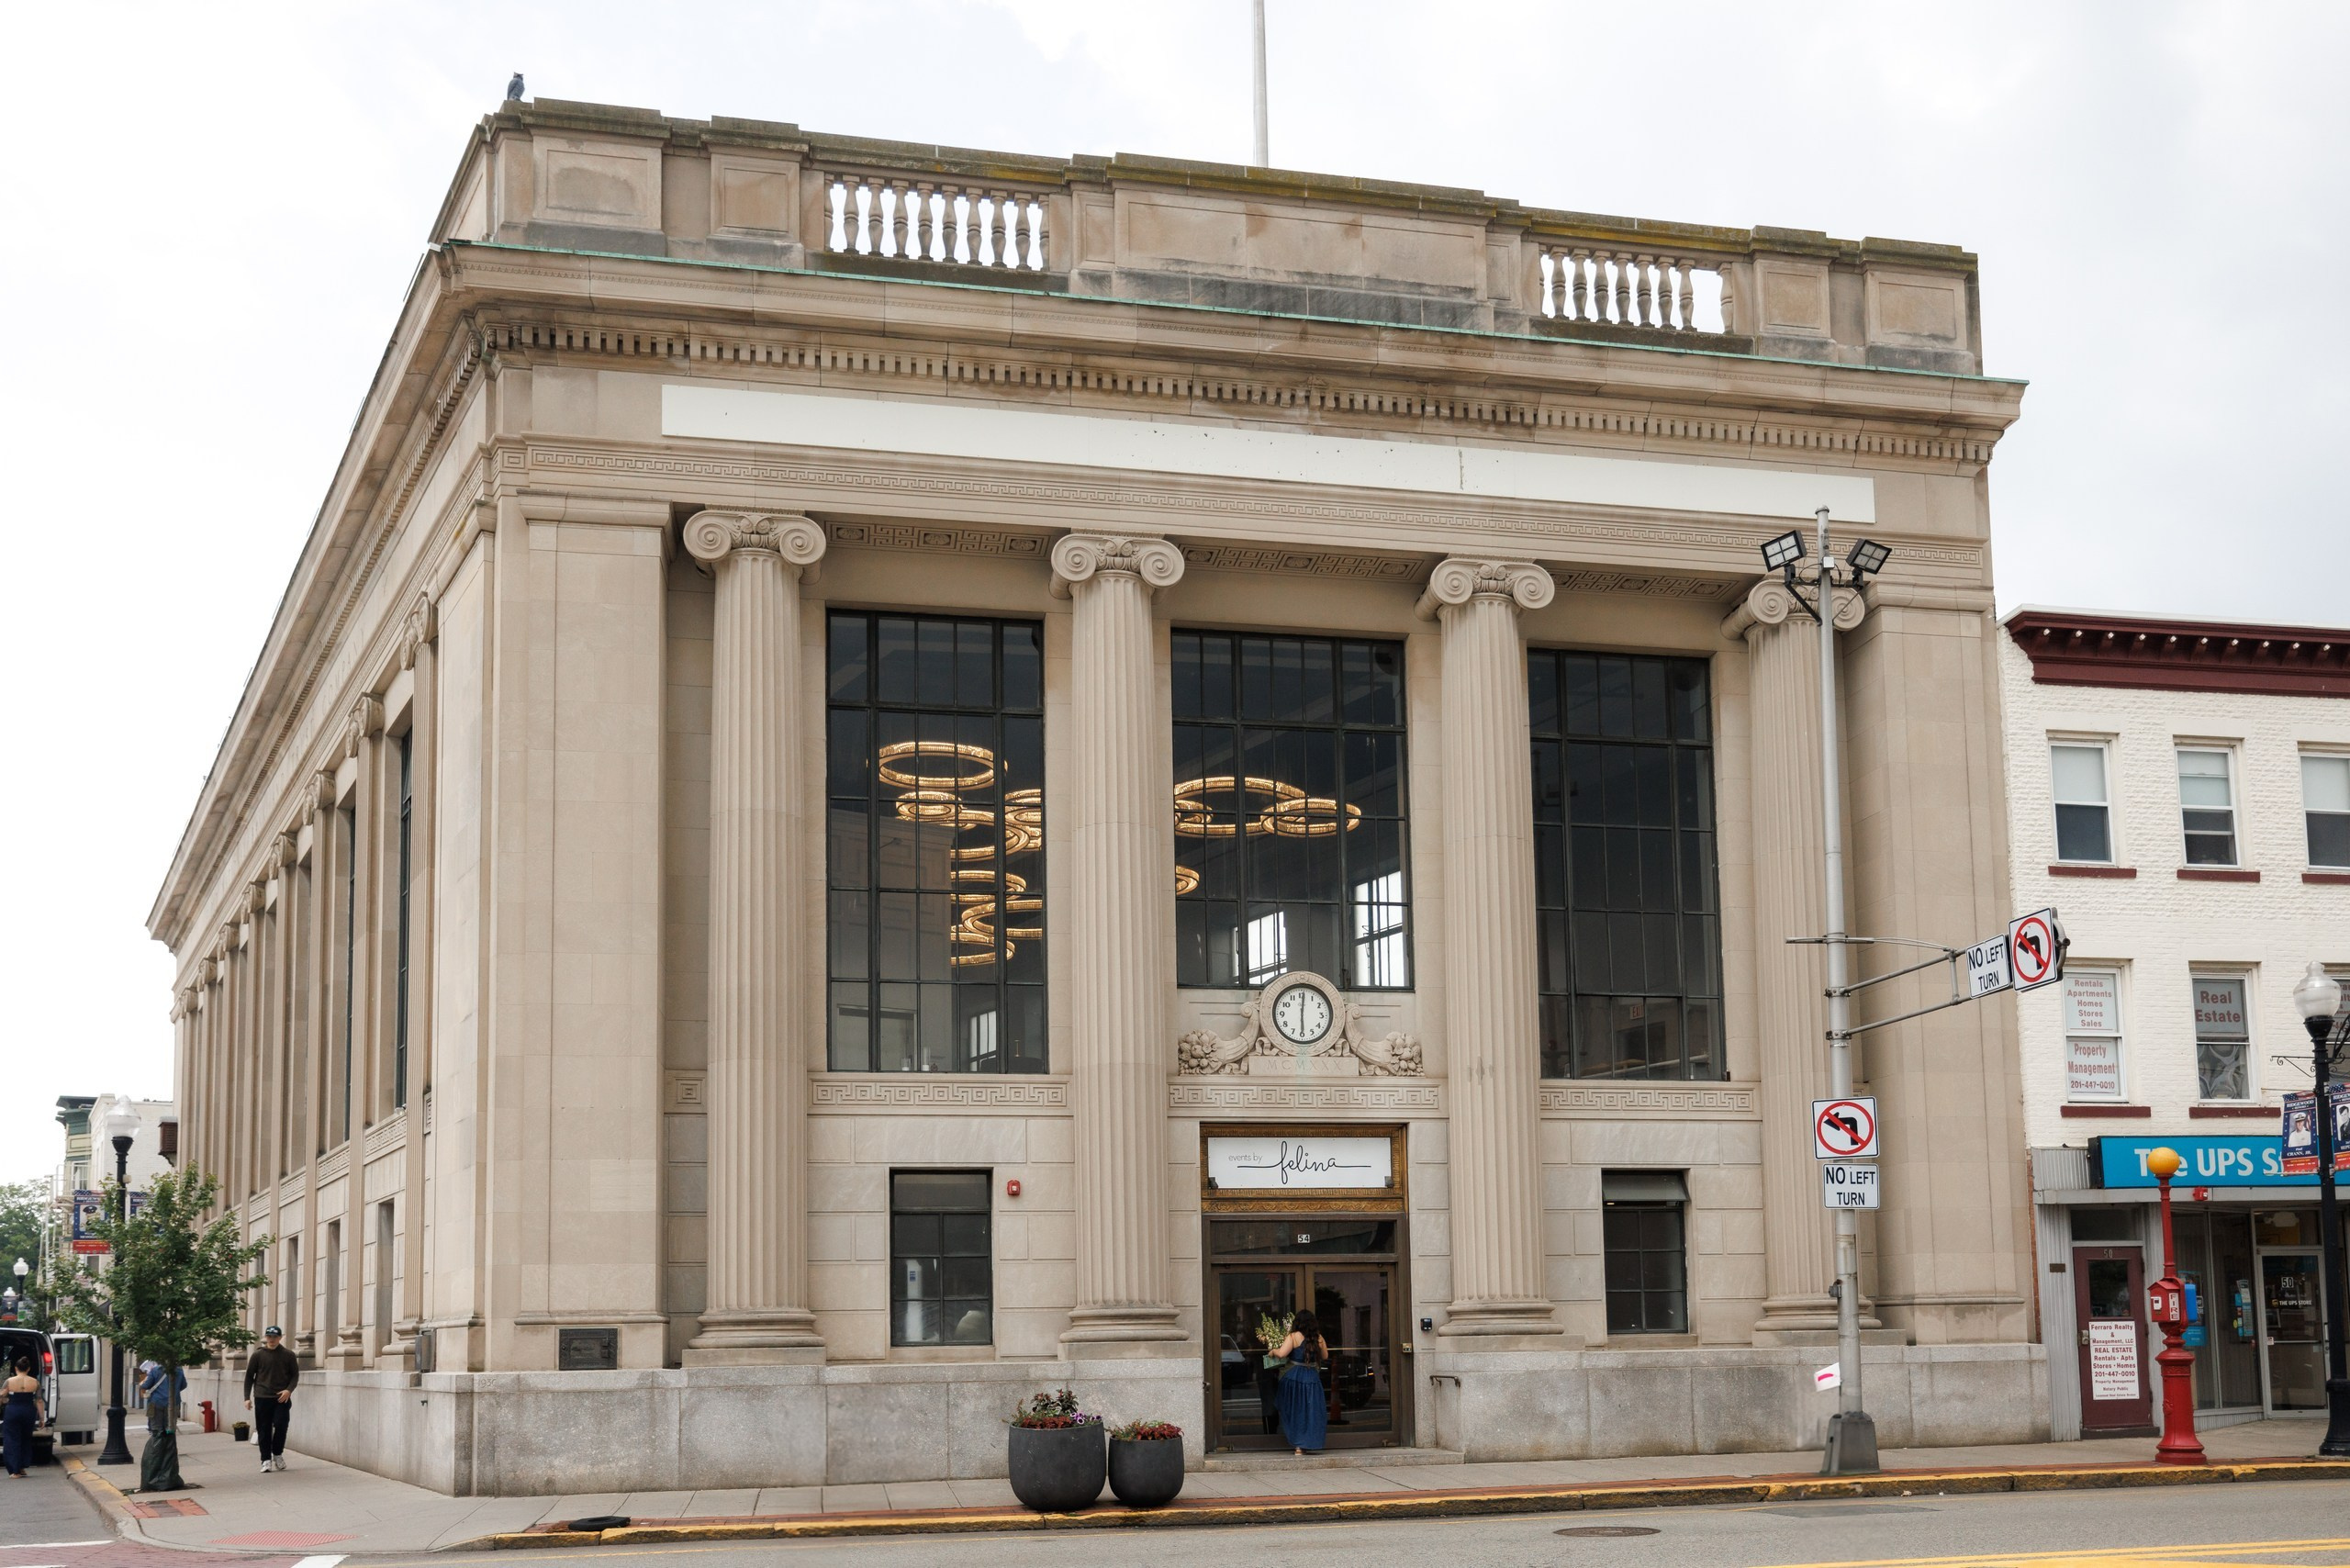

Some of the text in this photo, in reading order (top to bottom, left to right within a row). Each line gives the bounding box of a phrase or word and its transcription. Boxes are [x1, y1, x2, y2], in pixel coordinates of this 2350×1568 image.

[1968, 943, 2003, 970] NO LEFT
[1977, 969, 1999, 991] TURN
[2075, 980, 2103, 988] Rentals
[2067, 989, 2112, 998] Apartments
[2199, 991, 2232, 1003] Real
[2195, 1009, 2241, 1023] Estate
[2080, 1019, 2102, 1027] Sales
[2074, 1043, 2107, 1058] Property
[1267, 1059, 1344, 1070] MCMXXX
[2067, 1060, 2115, 1076] Management
[2070, 1080, 2115, 1090] 201-447-0010
[1253, 1153, 1263, 1164] by
[2133, 1148, 2188, 1177] Te
[2197, 1148, 2254, 1177] UPS
[1826, 1167, 1875, 1184] NO LEFT
[1837, 1193, 1865, 1205] TURN
[2104, 1249, 2113, 1259] 50
[2282, 1277, 2293, 1287] 50
[2170, 1294, 2178, 1319] FIRE
